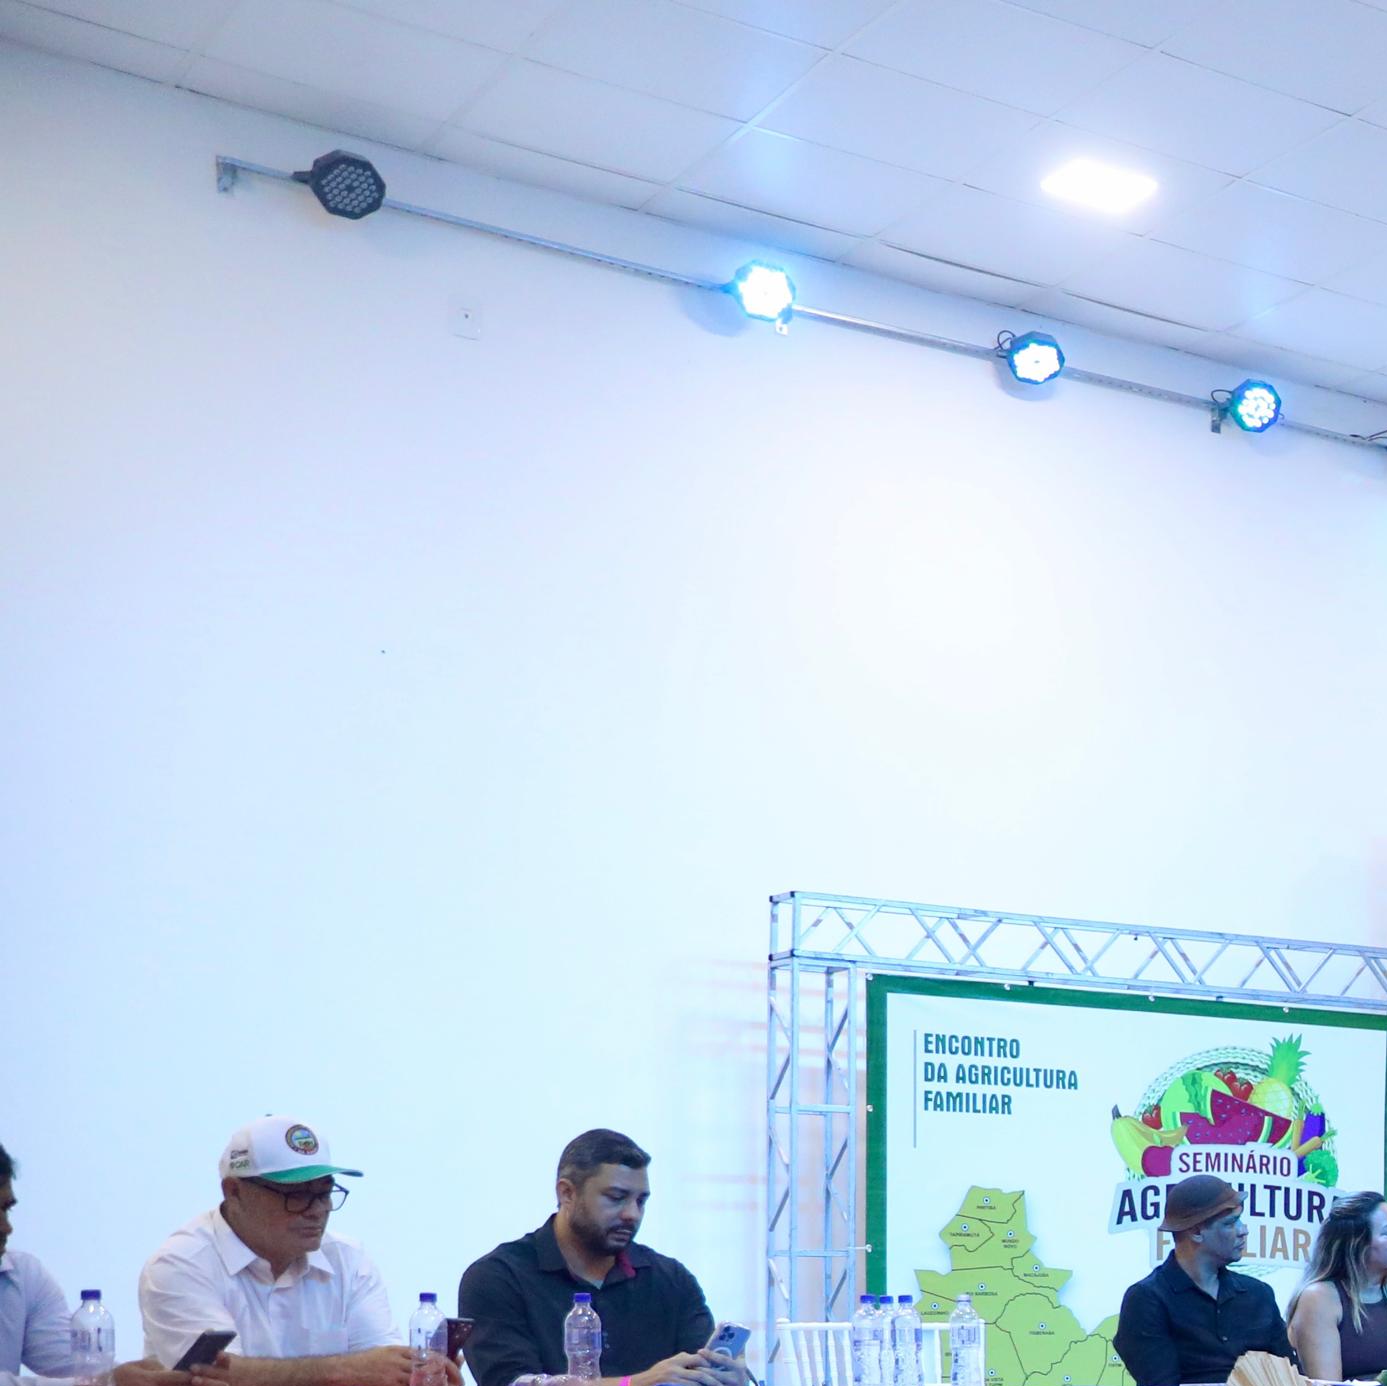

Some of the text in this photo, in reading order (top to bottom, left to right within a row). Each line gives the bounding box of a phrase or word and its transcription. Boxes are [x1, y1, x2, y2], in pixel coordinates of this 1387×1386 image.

[924, 1032, 1020, 1059] ENCONTRO
[924, 1062, 1078, 1090] DA AGRICULTURA
[924, 1090, 1012, 1115] FAMILIAR
[1178, 1150, 1292, 1177] SEMINÁRIO
[1116, 1183, 1340, 1225] AGLTUR
[1156, 1224, 1312, 1262] FLIAR
